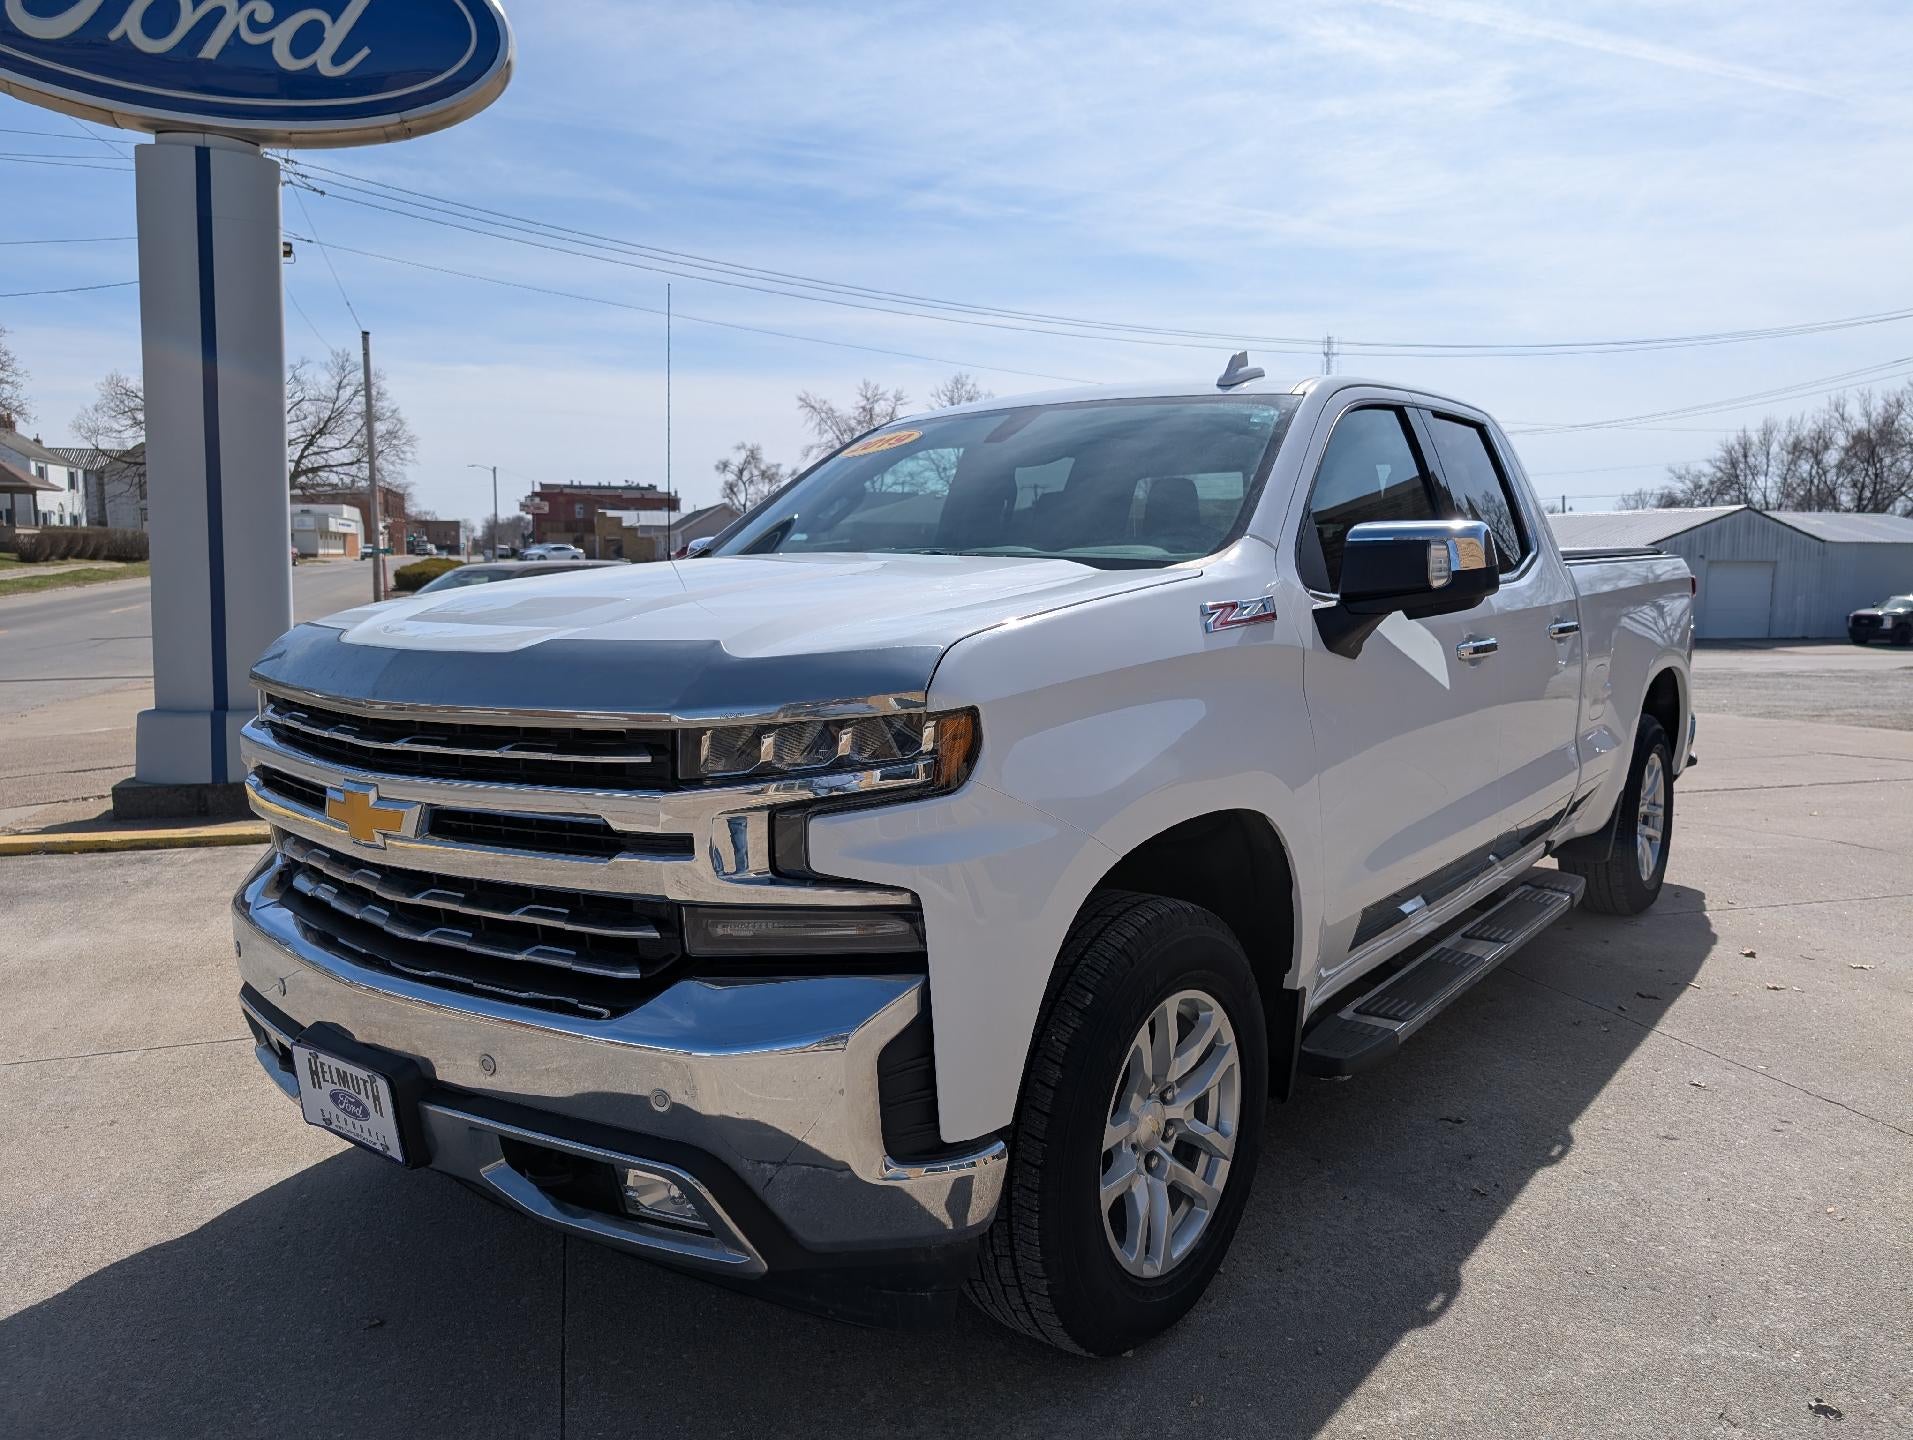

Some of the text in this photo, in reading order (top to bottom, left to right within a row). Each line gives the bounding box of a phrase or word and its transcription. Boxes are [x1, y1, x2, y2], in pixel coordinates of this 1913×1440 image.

[1200, 595, 1277, 633] Z71
[307, 1053, 384, 1119] HELMUTH
[337, 1093, 364, 1119] Ford
